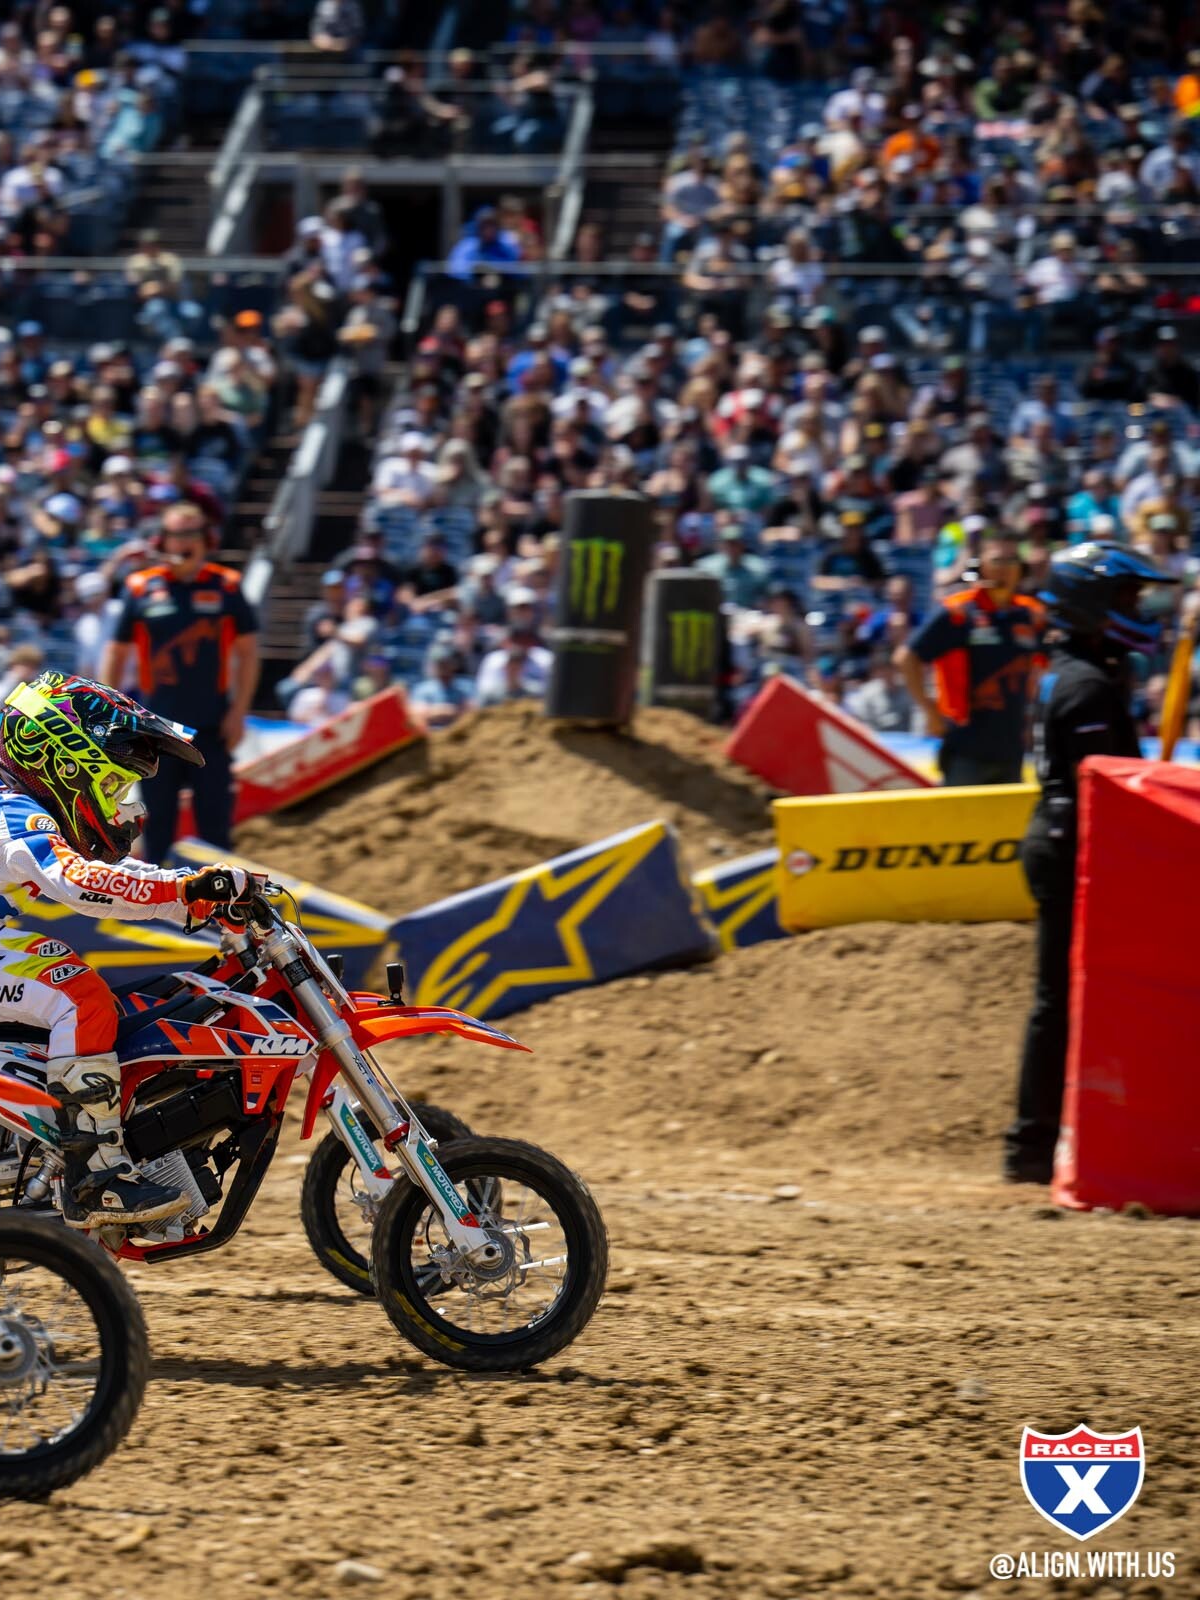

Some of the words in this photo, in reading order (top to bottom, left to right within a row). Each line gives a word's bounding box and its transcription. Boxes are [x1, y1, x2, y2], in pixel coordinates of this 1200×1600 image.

[39, 706, 110, 775] 100%
[828, 838, 1022, 872] DUNLO
[79, 891, 114, 905] KTM
[250, 1034, 309, 1055] KTM
[352, 1126, 380, 1170] MOTOREX
[431, 1165, 466, 1213] MOTOREX
